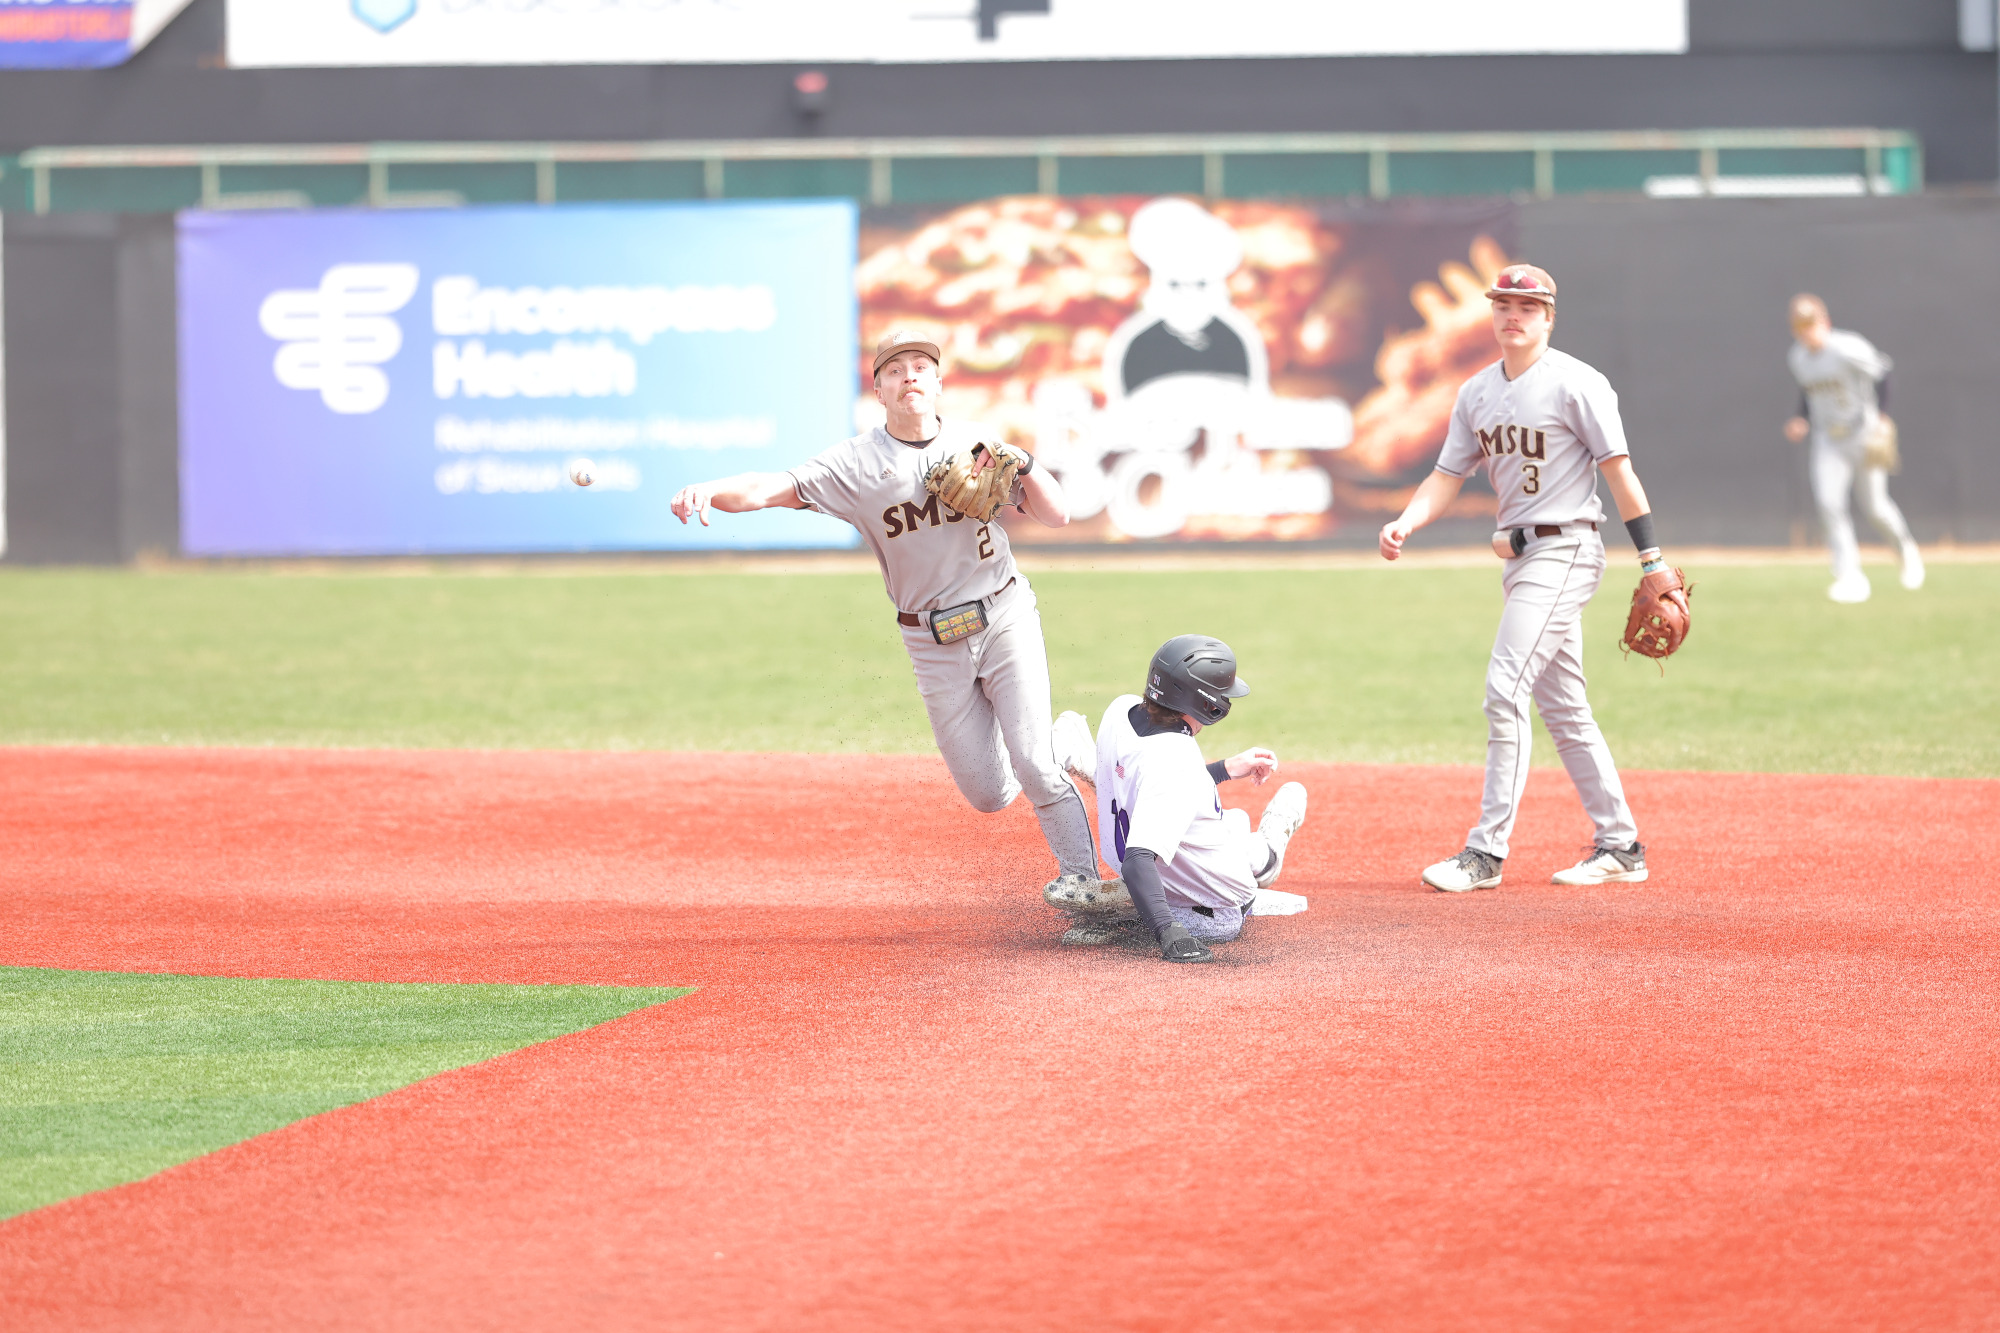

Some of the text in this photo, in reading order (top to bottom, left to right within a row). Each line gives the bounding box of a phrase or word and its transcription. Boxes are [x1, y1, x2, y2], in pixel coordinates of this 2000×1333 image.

[434, 275, 776, 345] Encompass
[434, 340, 637, 398] Health
[1474, 424, 1546, 461] MSU
[1522, 463, 1540, 495] 3
[882, 493, 975, 540] SMS
[976, 525, 995, 561] 2
